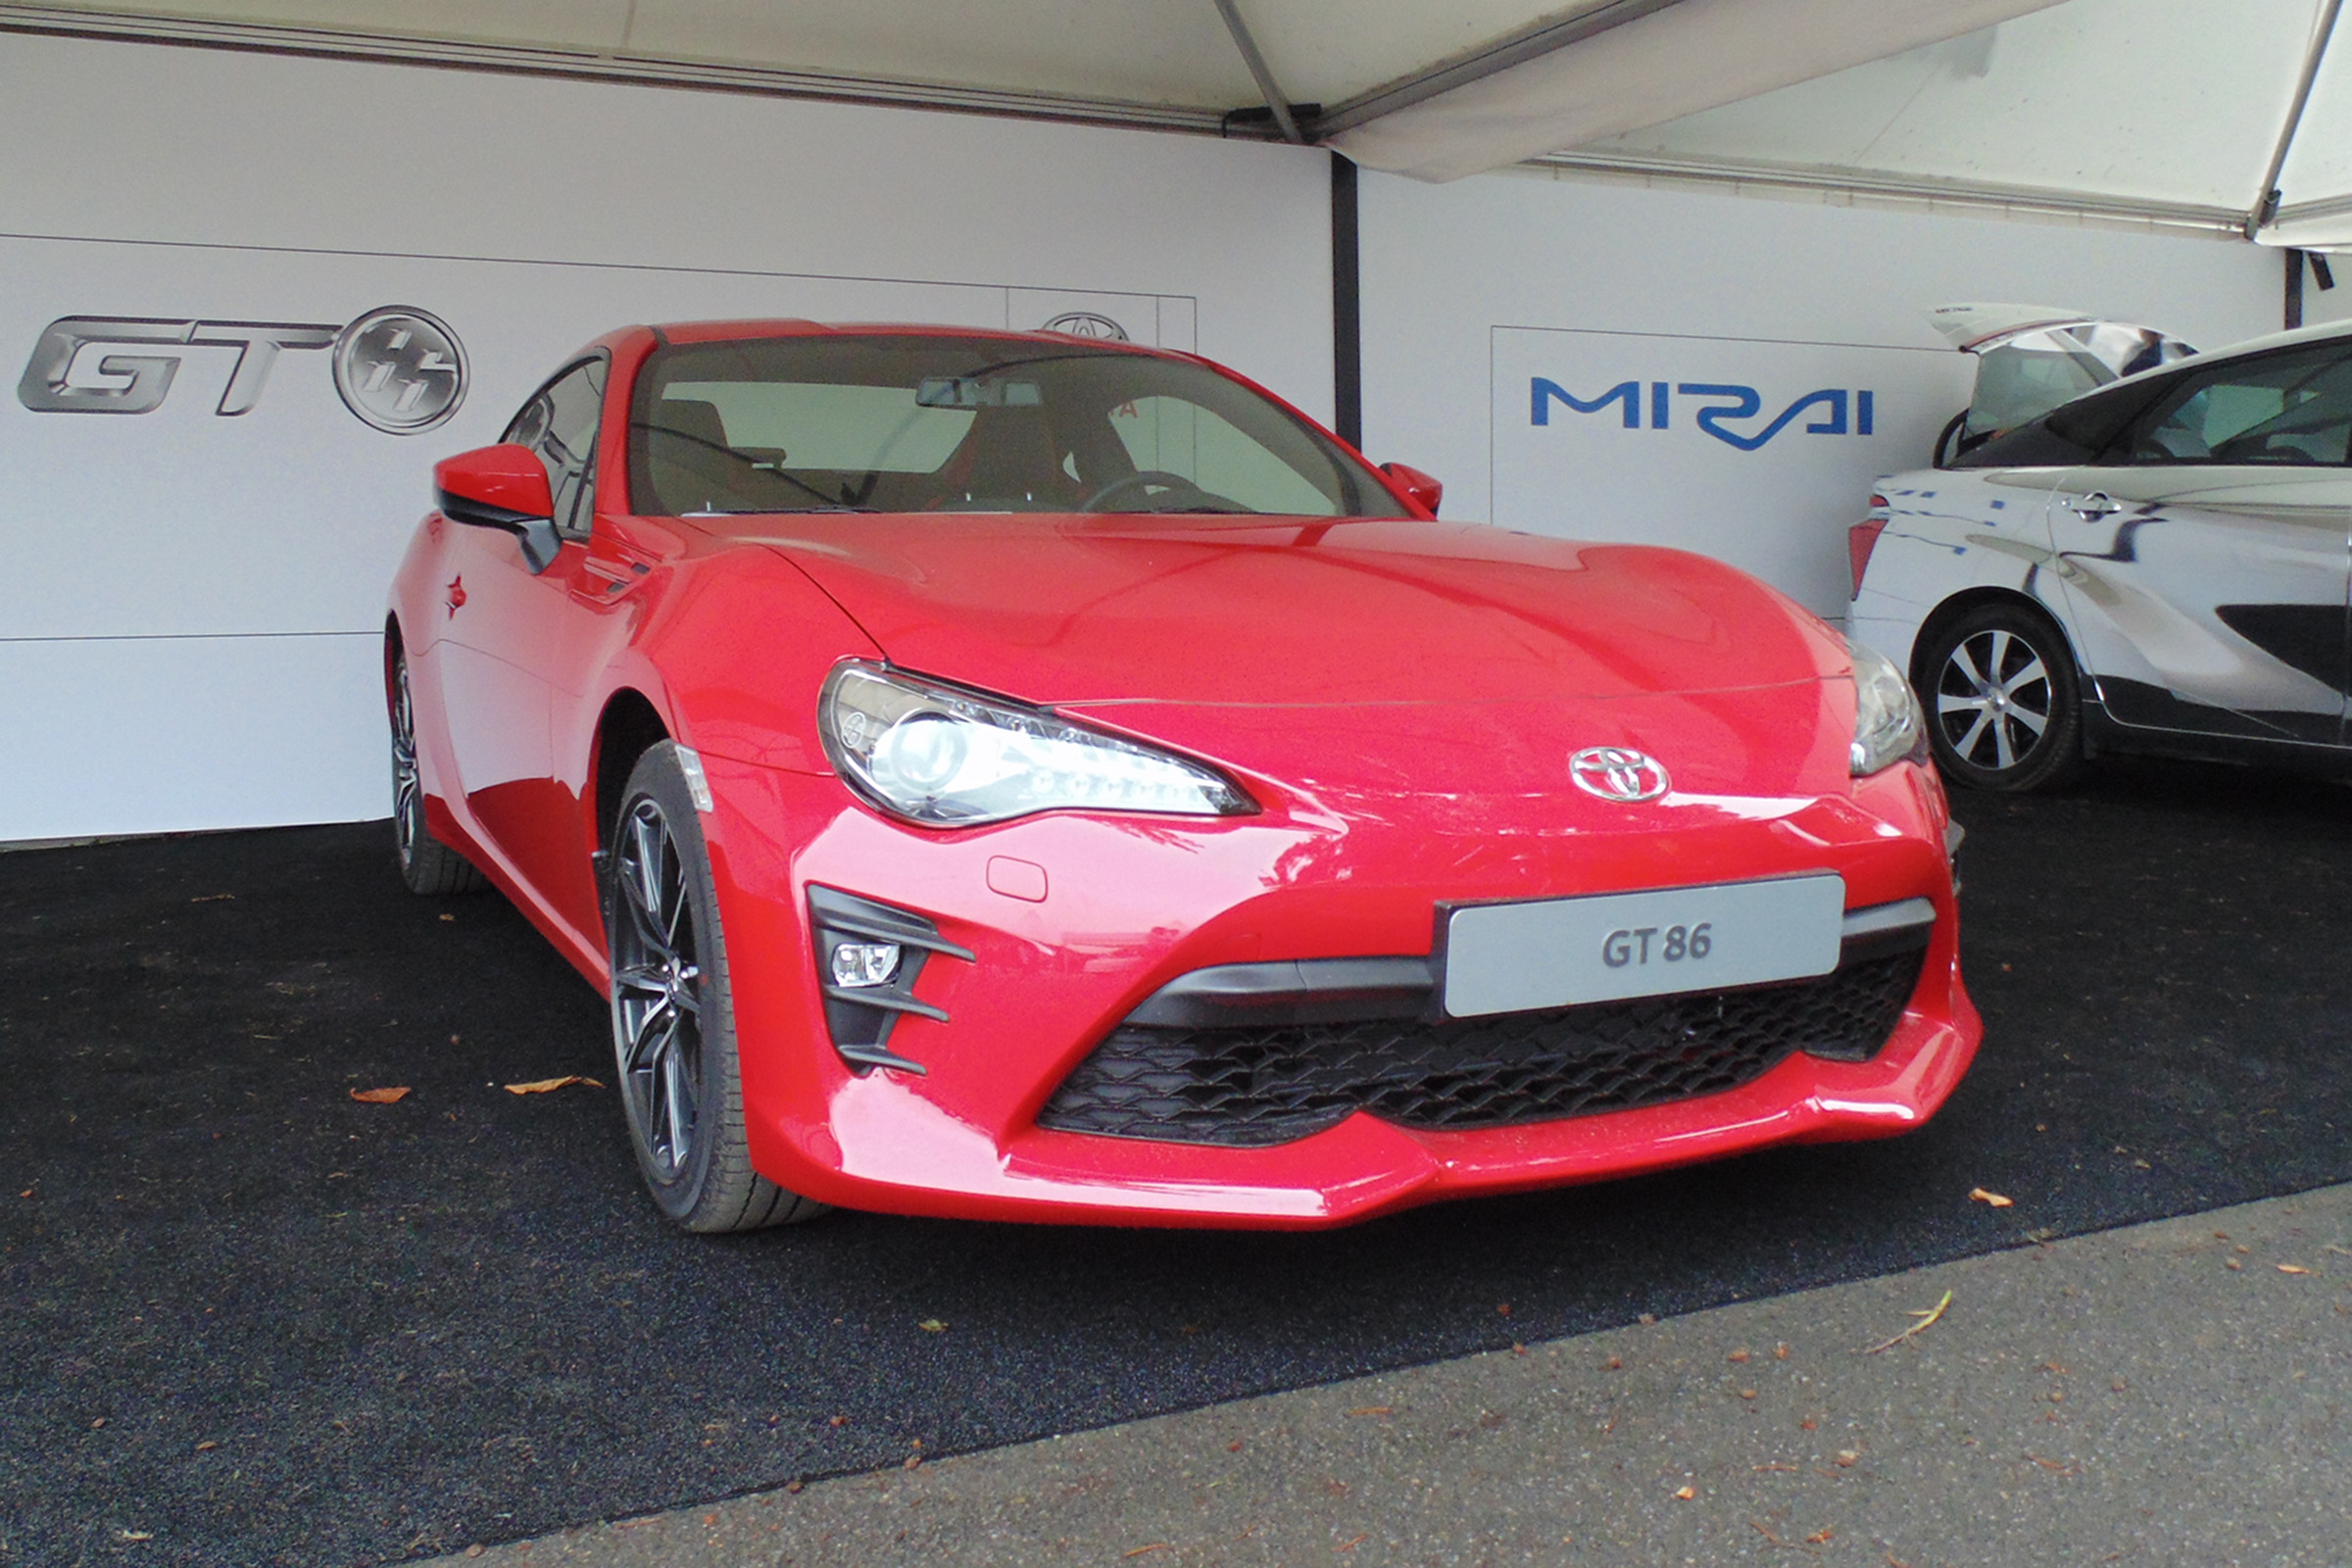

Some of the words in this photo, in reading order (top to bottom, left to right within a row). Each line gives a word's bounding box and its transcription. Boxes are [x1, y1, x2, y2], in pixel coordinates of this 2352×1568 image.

[1531, 376, 1874, 451] MIRAI
[1601, 927, 1658, 968] GT
[1663, 921, 1712, 962] 86
